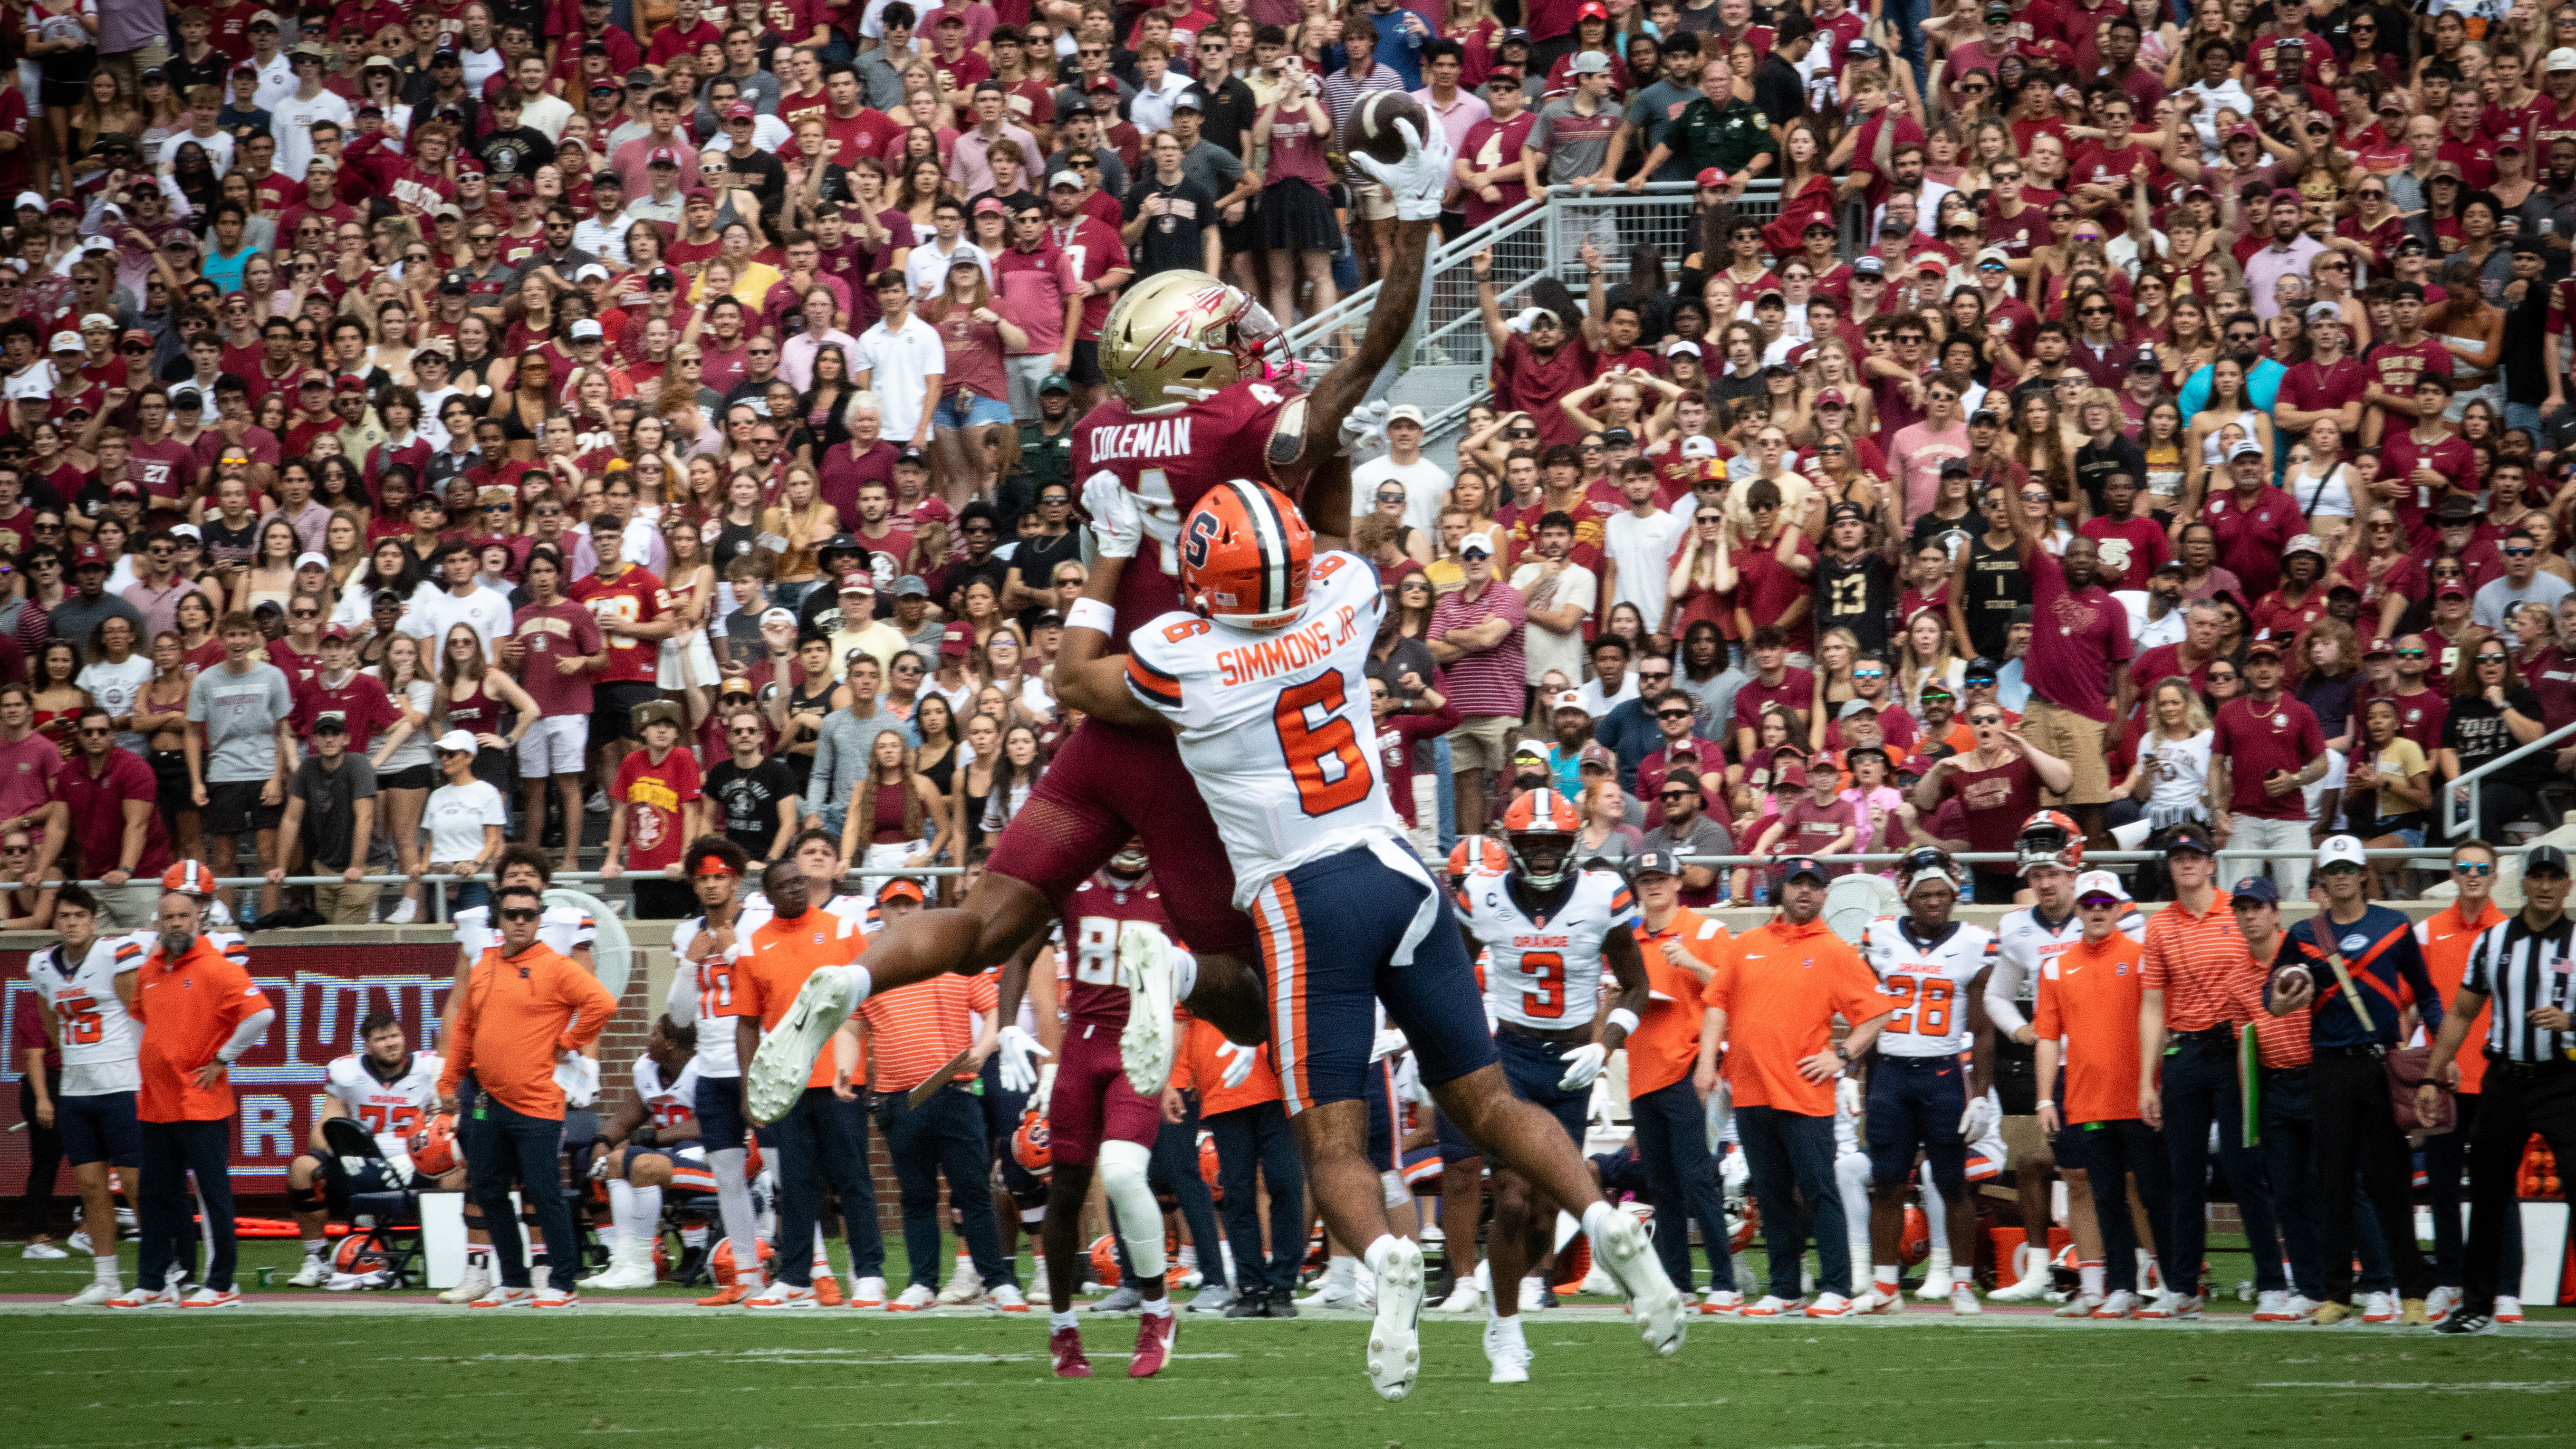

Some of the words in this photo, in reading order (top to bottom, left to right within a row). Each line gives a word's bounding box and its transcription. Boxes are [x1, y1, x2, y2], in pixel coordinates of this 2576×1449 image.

[1249, 383, 1284, 407] 4
[1090, 417, 1191, 463] COLEMAN
[144, 464, 172, 484] 27
[1183, 509, 1220, 570] S
[1831, 573, 1867, 616] 13
[1216, 621, 1331, 687] SIMMONS
[1335, 605, 1359, 647] JR
[1273, 667, 1374, 817] 6
[1485, 892, 1497, 908] C
[1512, 935, 1569, 949] ORANGE
[1520, 951, 1566, 1018] 3
[1897, 963, 1942, 975] ORANGE
[56, 987, 87, 999] ORANGE
[1886, 975, 1955, 1036] 28
[55, 998, 102, 1045] 15
[370, 1095, 409, 1105] ORANGE
